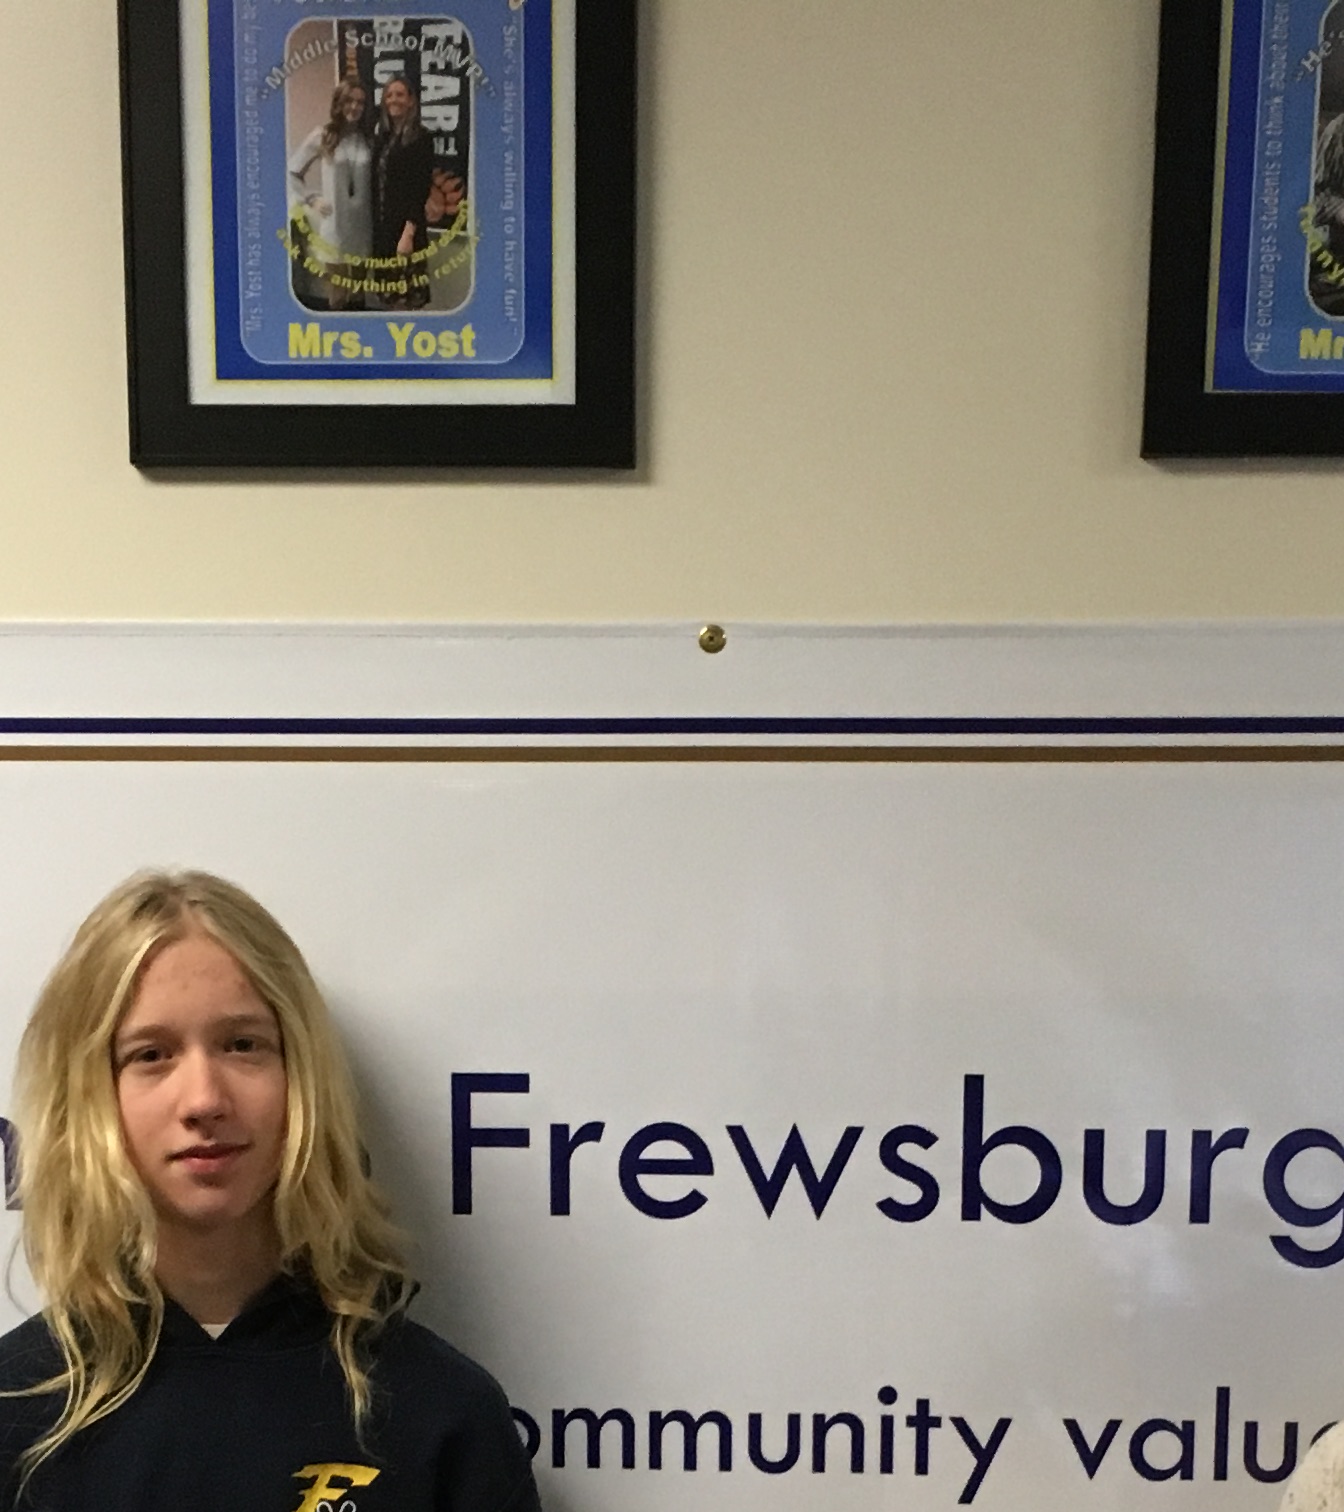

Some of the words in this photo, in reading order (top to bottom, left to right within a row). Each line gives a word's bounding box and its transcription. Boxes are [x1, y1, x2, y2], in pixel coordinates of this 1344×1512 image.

[241, 48, 257, 64] do
[242, 68, 257, 82] to
[244, 86, 258, 106] me
[500, 81, 517, 144] always
[242, 110, 264, 189] encouraged
[500, 151, 517, 210] willing
[244, 193, 266, 239] always
[504, 216, 516, 233] to
[245, 243, 262, 267] has
[365, 254, 407, 269] much
[411, 240, 438, 263] and
[504, 240, 517, 282] have
[331, 274, 407, 293] anything
[412, 273, 429, 287] in
[1256, 235, 1281, 327] encourages
[288, 322, 373, 358] Mrs.
[387, 321, 476, 358] Yost
[1063, 1387, 1338, 1483] valu
